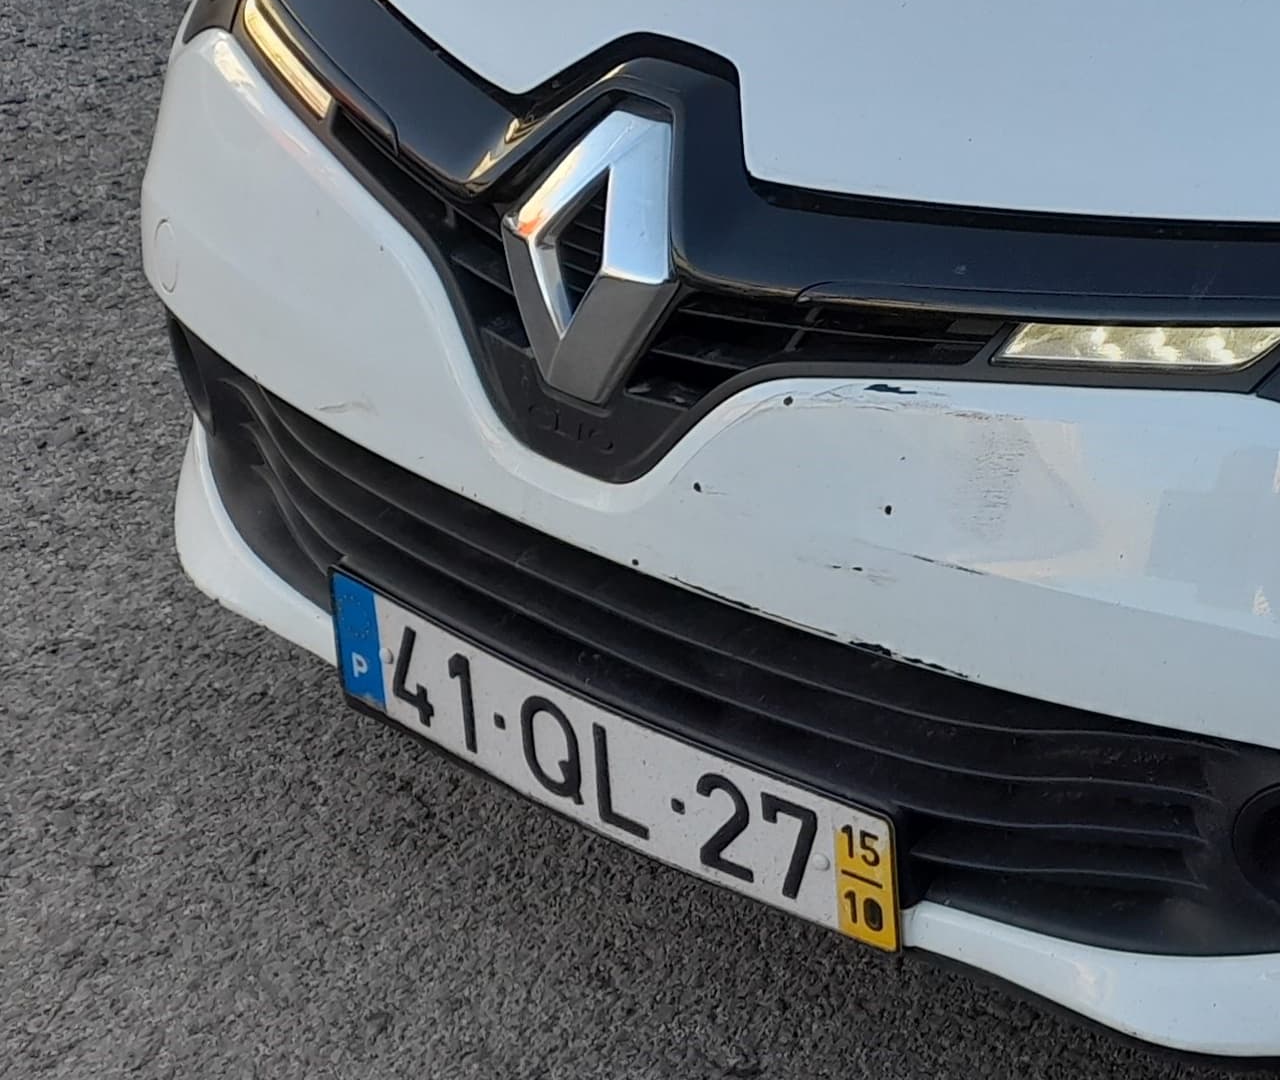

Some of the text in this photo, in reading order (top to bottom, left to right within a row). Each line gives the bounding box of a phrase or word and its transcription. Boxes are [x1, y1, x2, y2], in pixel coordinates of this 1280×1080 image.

[351, 652, 368, 678] P
[842, 824, 881, 866] 15
[843, 890, 882, 932] 10
